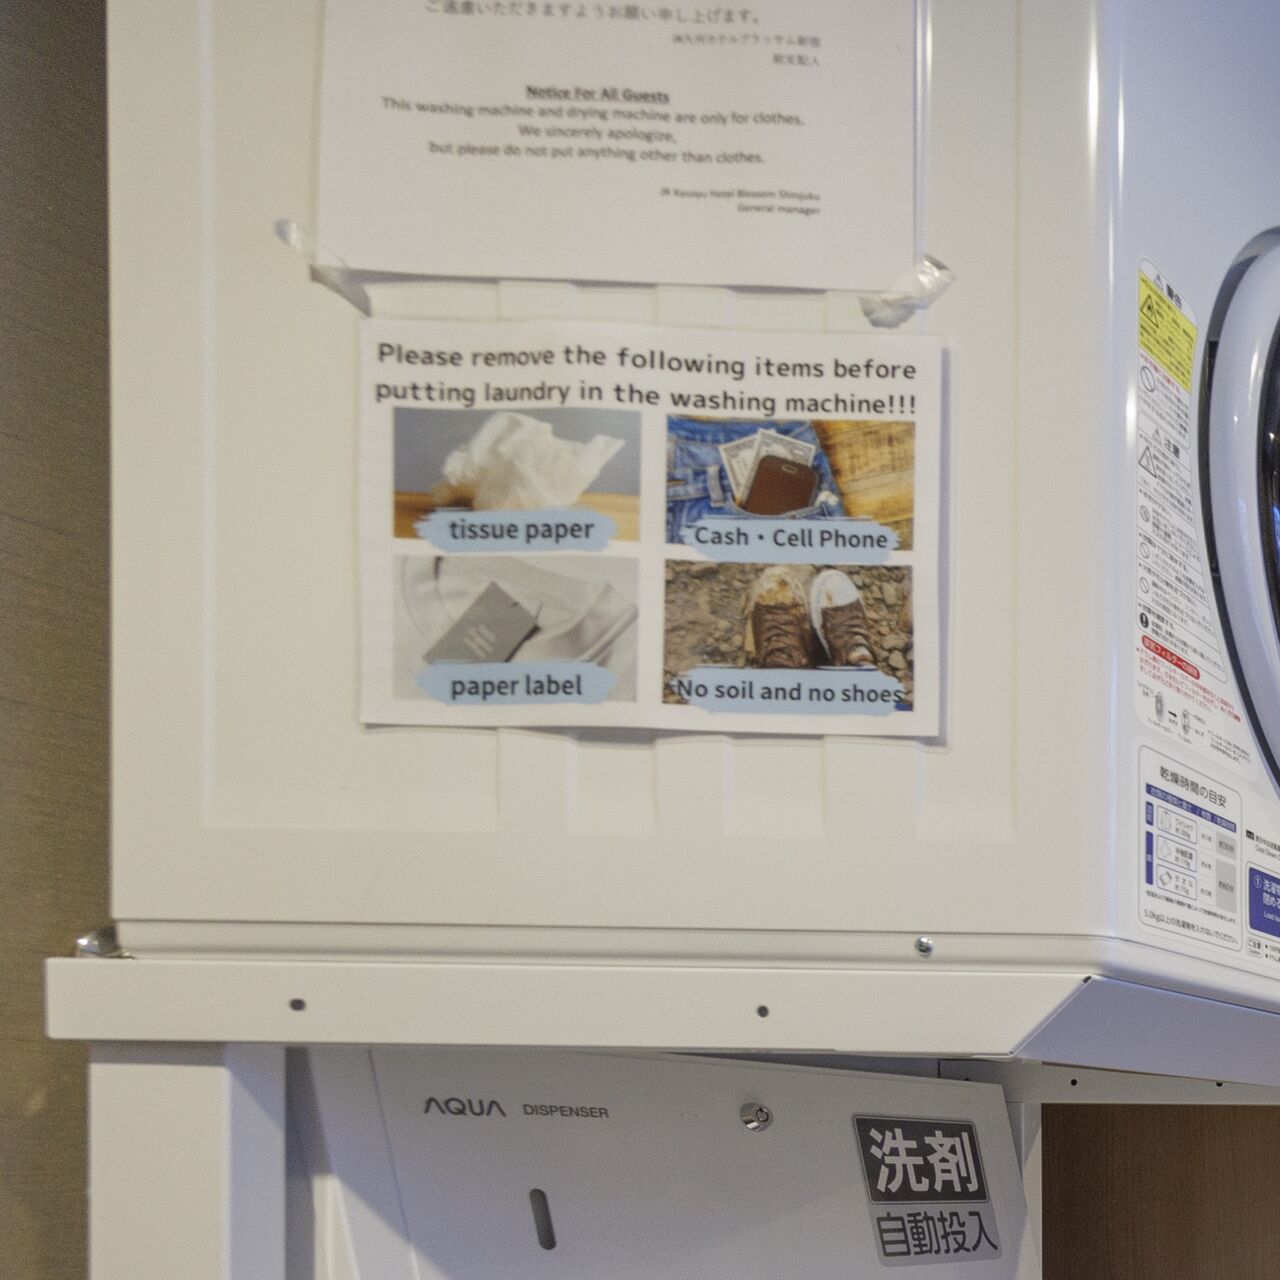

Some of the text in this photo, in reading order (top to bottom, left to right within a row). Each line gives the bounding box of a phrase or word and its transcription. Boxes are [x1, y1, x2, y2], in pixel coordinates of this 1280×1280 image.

[526, 85, 670, 104] Notice For All Guests
[382, 95, 805, 126] This washing machine and drying machine are only for clothes.
[519, 123, 603, 140] We sincerely
[429, 141, 453, 154] but
[457, 144, 500, 157] please
[503, 145, 522, 156] do
[524, 147, 549, 158] not
[551, 147, 574, 159] put
[577, 147, 636, 162] anything
[640, 150, 678, 162] other
[681, 151, 712, 164] than
[377, 341, 917, 381] Please remove the following items before
[374, 380, 917, 417] putting laundry in the washing machine!!!
[448, 518, 596, 547] tissue paper
[694, 525, 889, 550] Cash Cell Phone
[451, 672, 582, 701] paper label
[677, 679, 904, 705] No soil and no shoes
[1160, 765, 1227, 808] 乾燥時間の目安
[423, 1097, 609, 1119] AQUA DISPENSER
[870, 1127, 979, 1195] 洗剤
[876, 1210, 999, 1258] 自動投入
